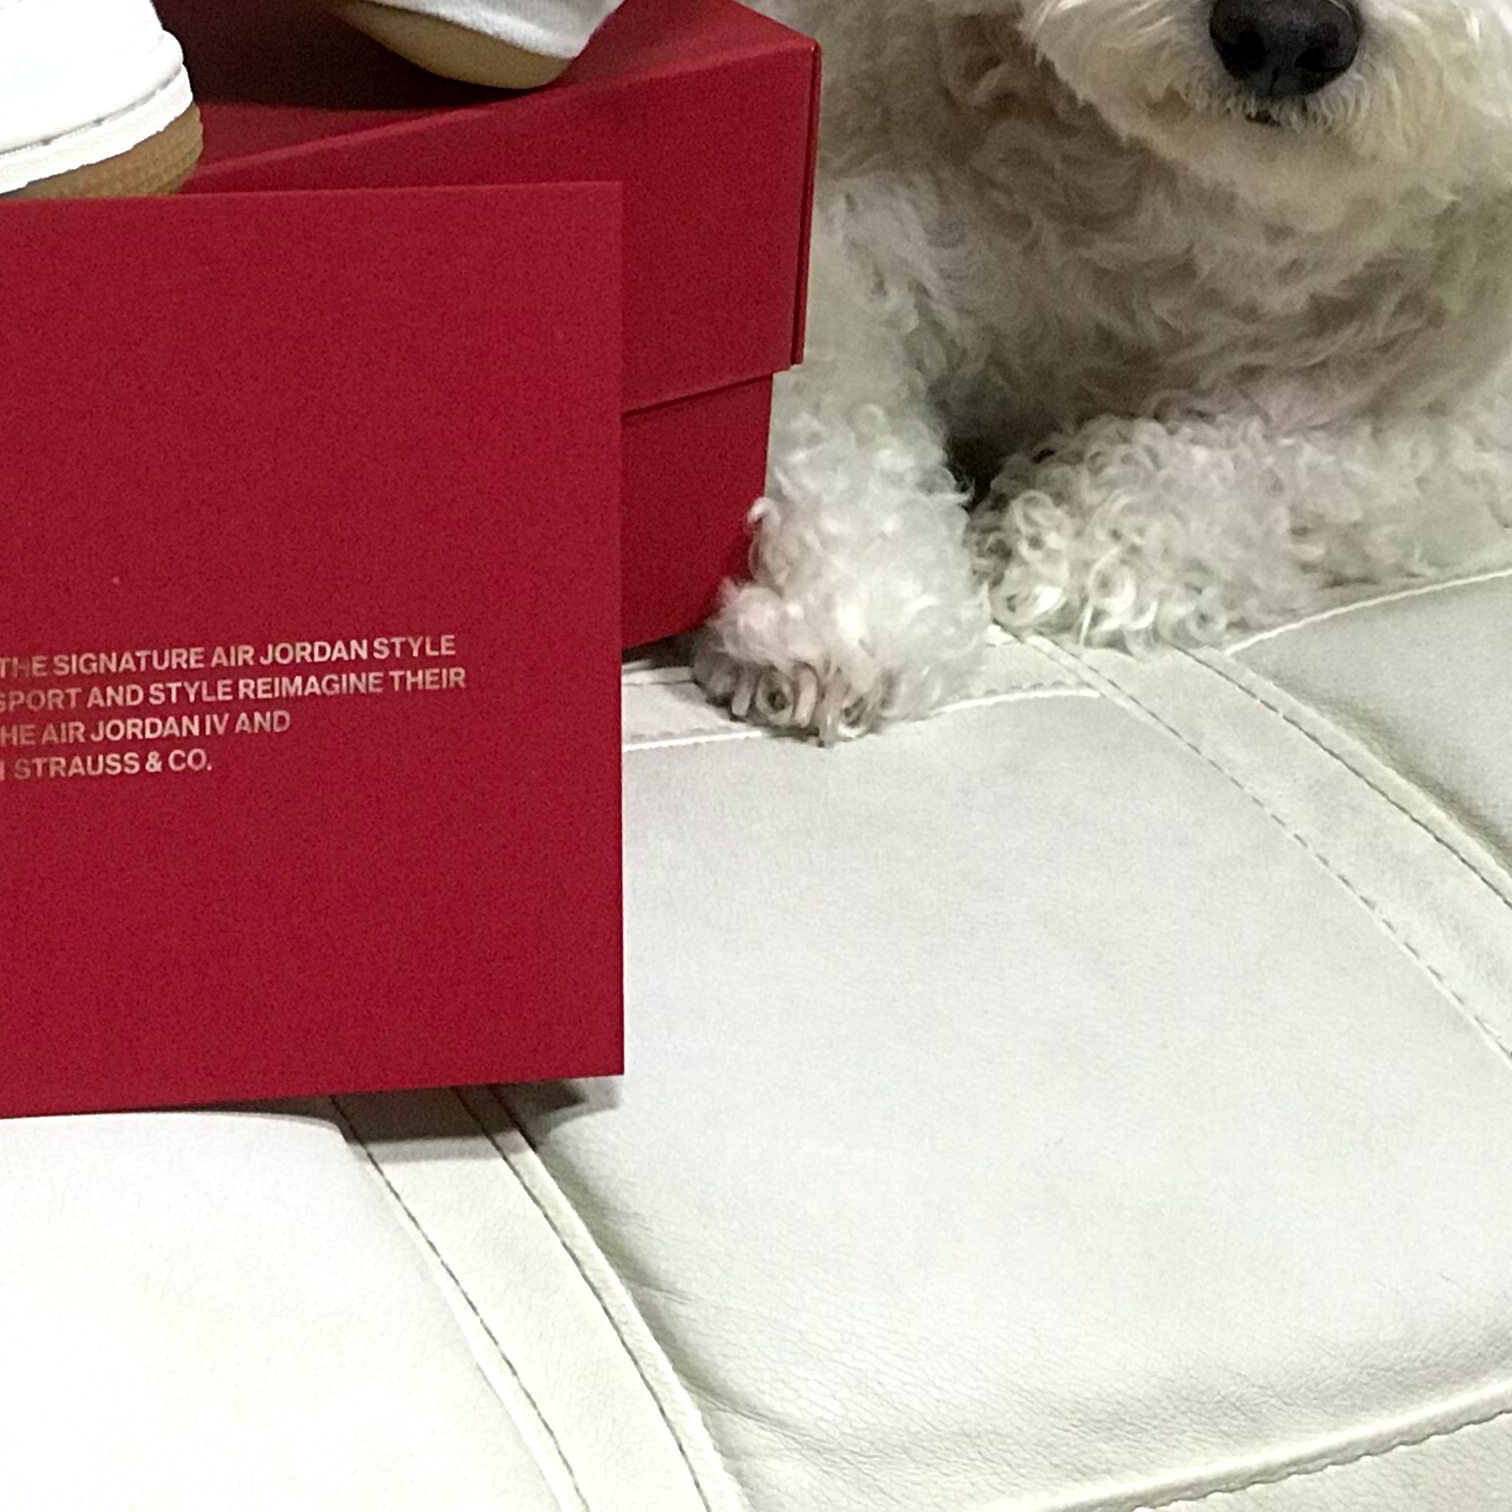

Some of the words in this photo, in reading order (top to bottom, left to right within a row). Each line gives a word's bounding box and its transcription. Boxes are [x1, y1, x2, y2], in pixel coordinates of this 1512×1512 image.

[53, 646, 205, 676] SIGNATURE
[210, 644, 256, 668] AIR
[259, 639, 368, 666] JORDAN
[372, 634, 457, 659] STYLE
[86, 684, 144, 708] AND
[148, 680, 234, 706] STYLE
[238, 671, 384, 700] REIMAGINE
[389, 666, 466, 691] THEIR
[41, 720, 86, 744] AIR
[90, 715, 200, 743] JORDAN
[205, 713, 230, 735] IV
[235, 709, 292, 734] AND
[13, 751, 140, 780] STRAUSS
[145, 751, 162, 773] &
[168, 748, 213, 772] CO.
